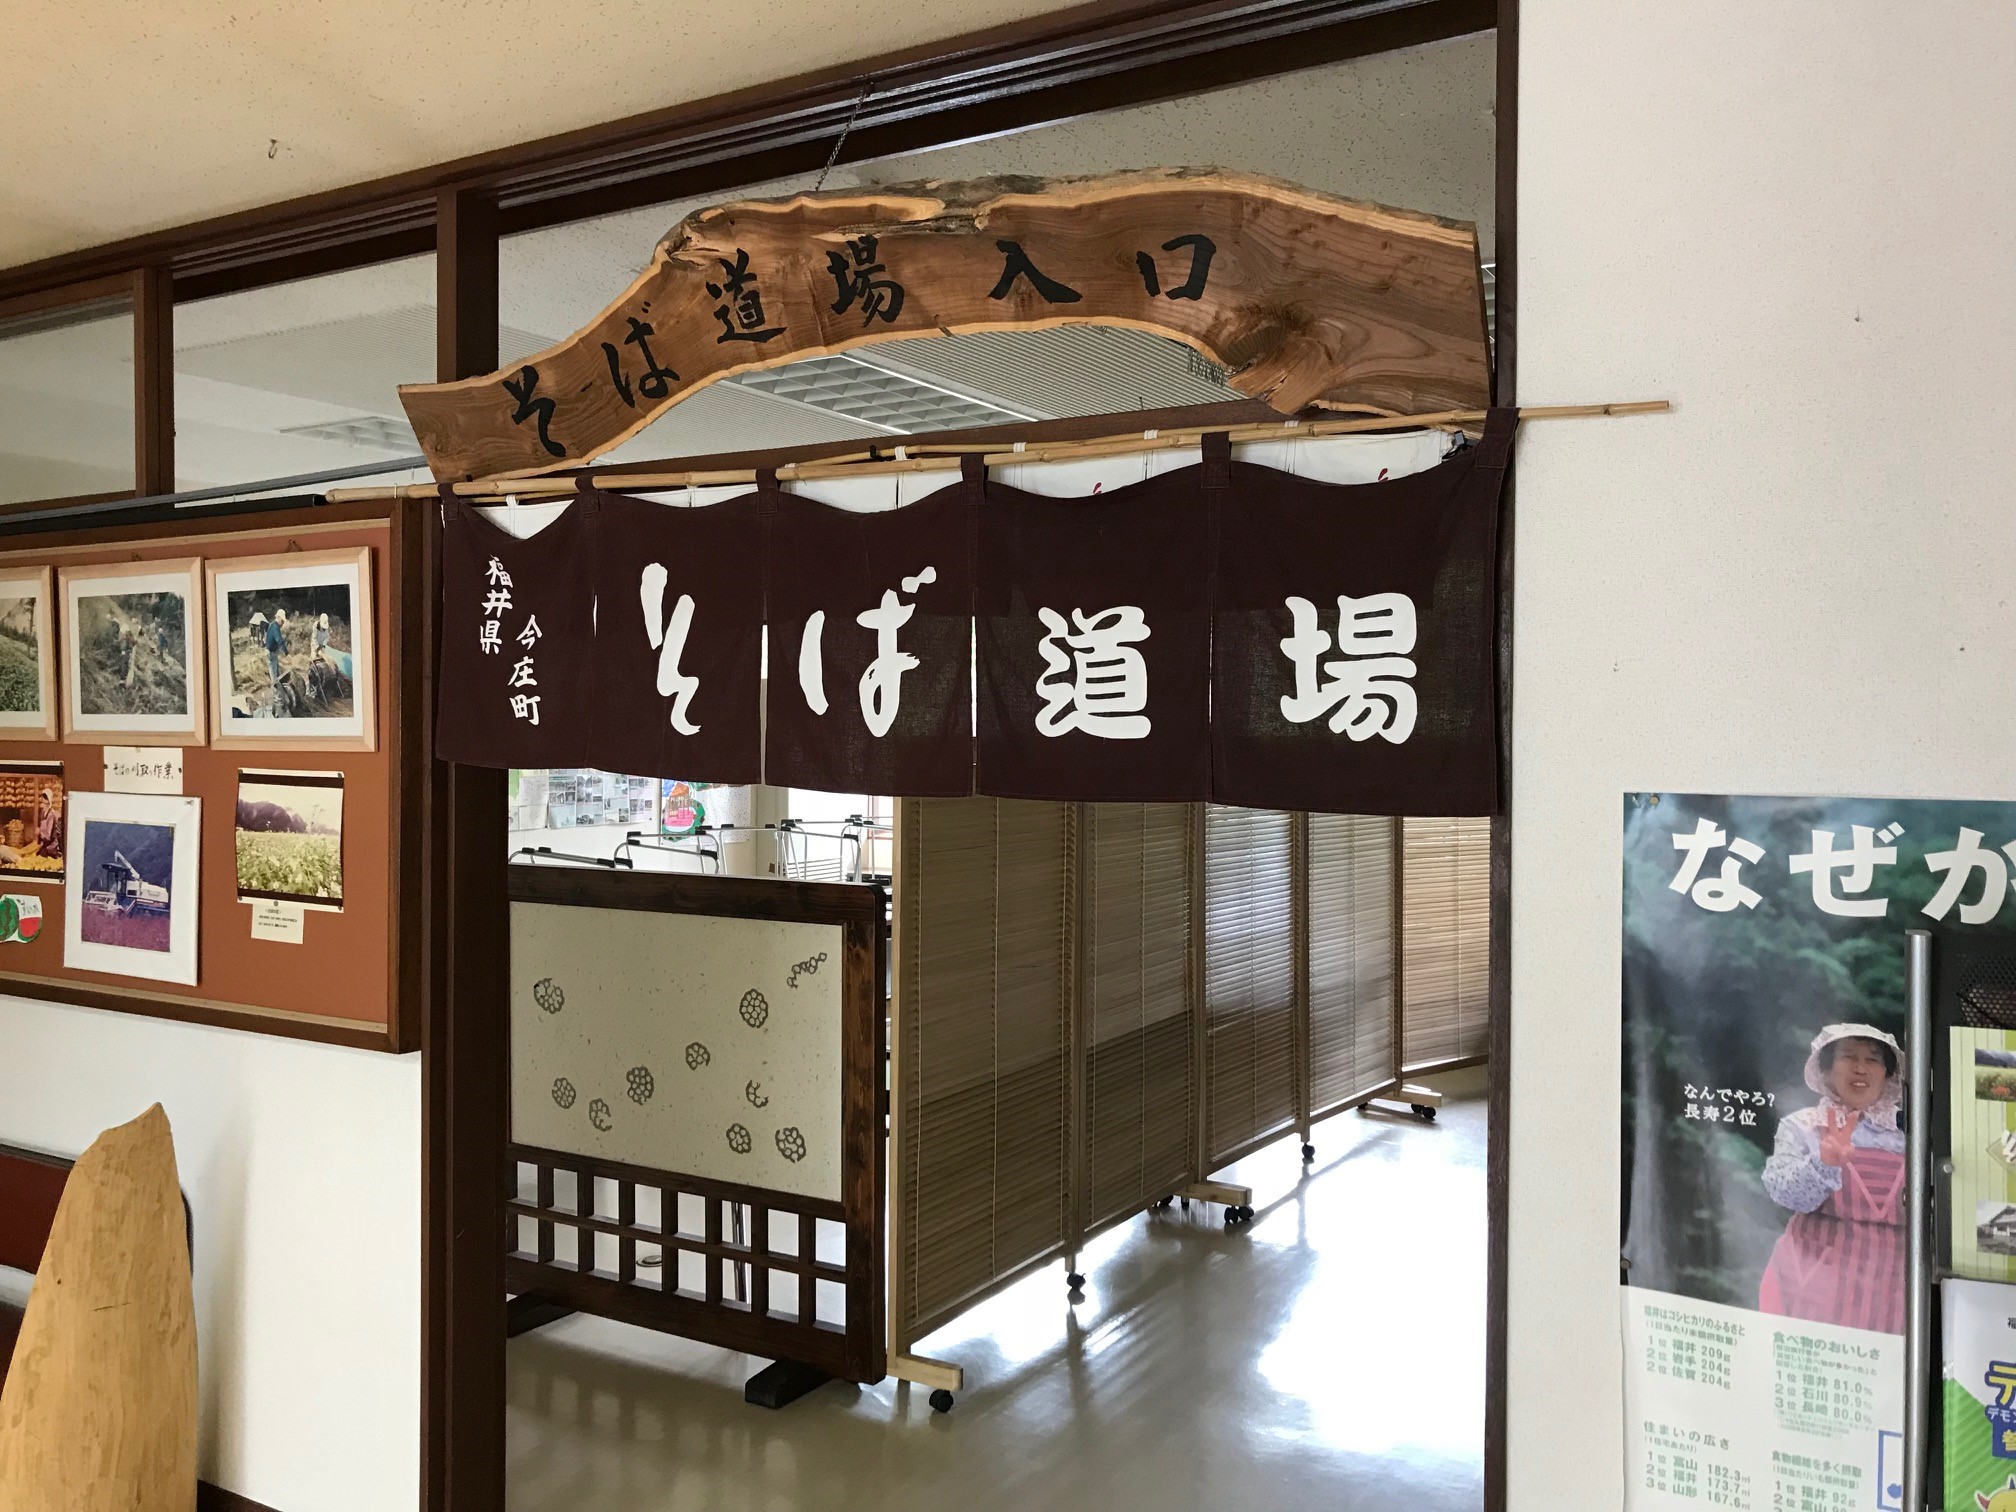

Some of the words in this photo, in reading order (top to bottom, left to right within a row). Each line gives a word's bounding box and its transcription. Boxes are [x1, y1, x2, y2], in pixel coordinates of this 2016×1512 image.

[502, 234, 1217, 458] そば道場入口
[480, 554, 513, 654] 福井県
[640, 562, 1418, 744] そば道場
[507, 614, 543, 726] 今庄町
[1684, 1103, 1757, 1126] 長寿2位
[1644, 1304, 1745, 1337] 福井はコシヒカリのふるさと
[1672, 1338, 1696, 1354] 福井
[1773, 1331, 1880, 1360] 食べ物のおいしさ
[1802, 1373, 1828, 1388] 福井
[1802, 1387, 1828, 1402] 石川
[1643, 1420, 1730, 1450] 住まいの広さ
[1672, 1455, 1698, 1471] 富山
[1672, 1469, 1698, 1484] 福井
[1801, 1485, 1827, 1501] 福井
